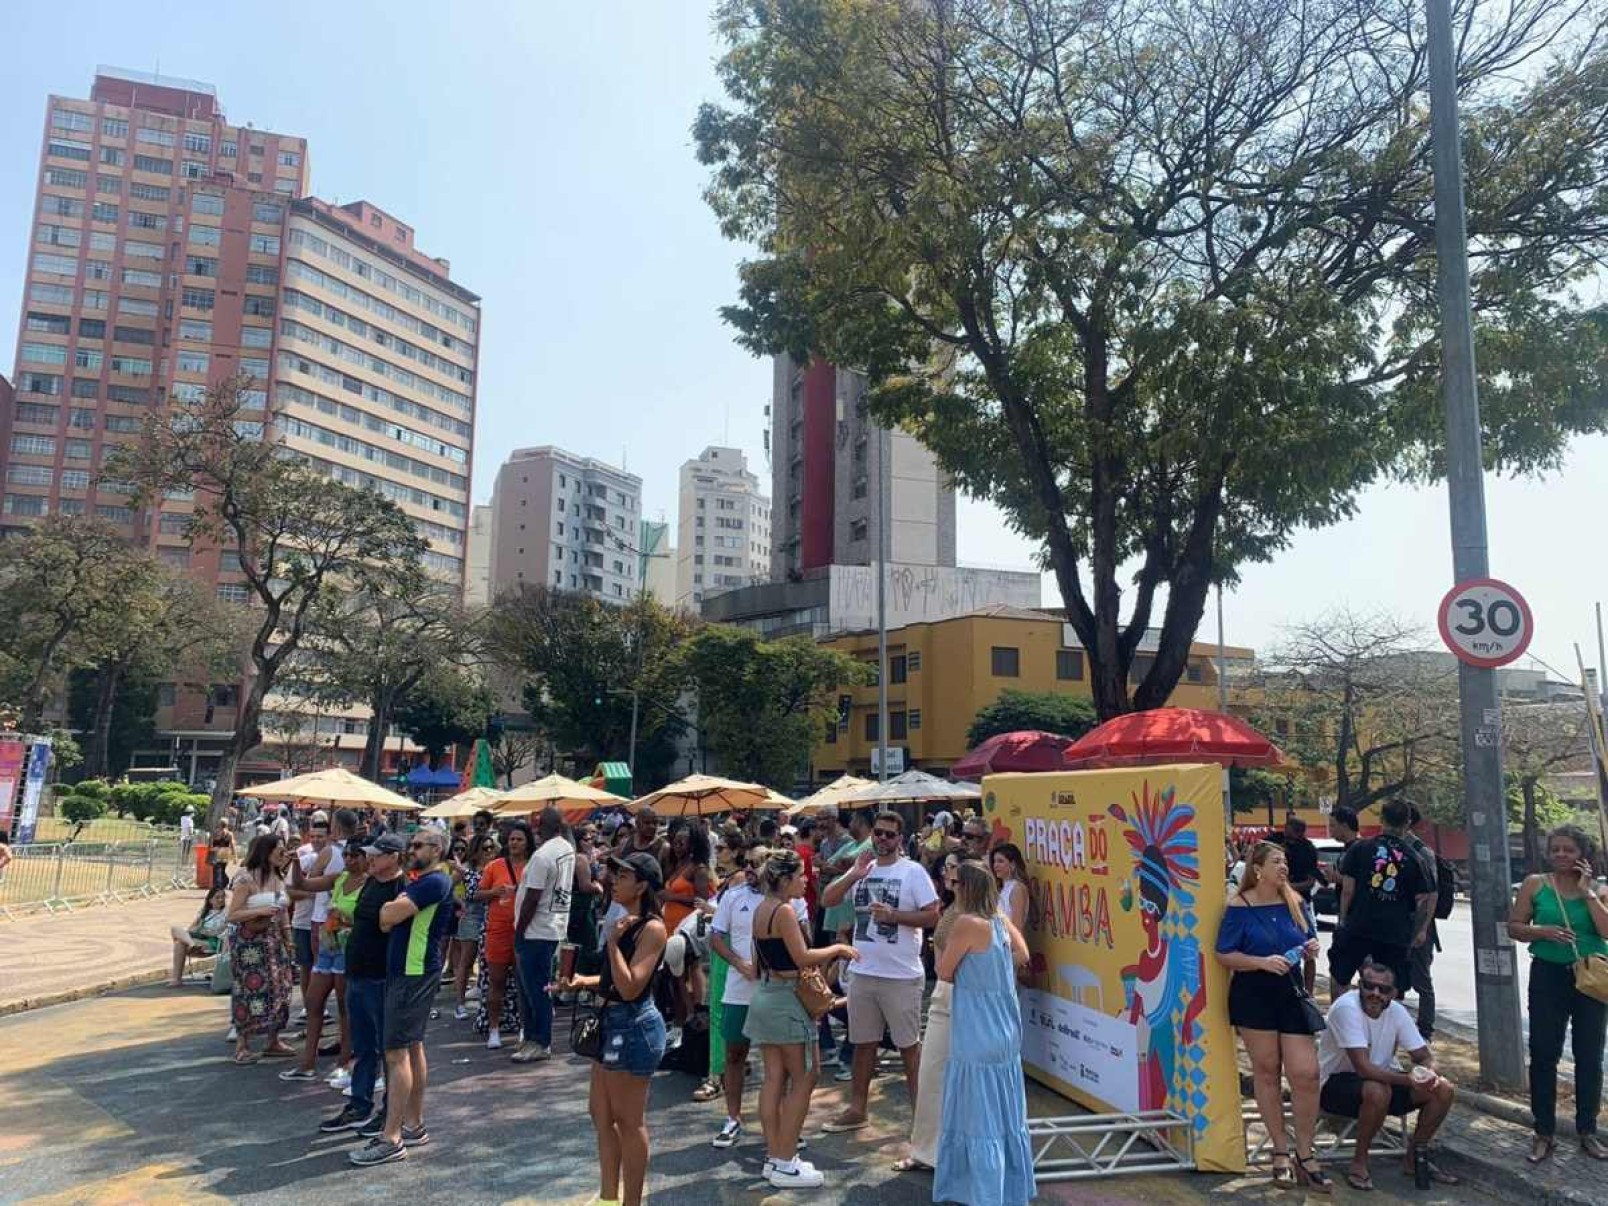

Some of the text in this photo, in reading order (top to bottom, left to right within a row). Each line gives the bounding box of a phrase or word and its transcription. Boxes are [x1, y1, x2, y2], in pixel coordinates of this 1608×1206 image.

[1455, 598, 1520, 636] 30
[1472, 641, 1503, 653] km/h
[1024, 816, 1086, 874] PRAÇA
